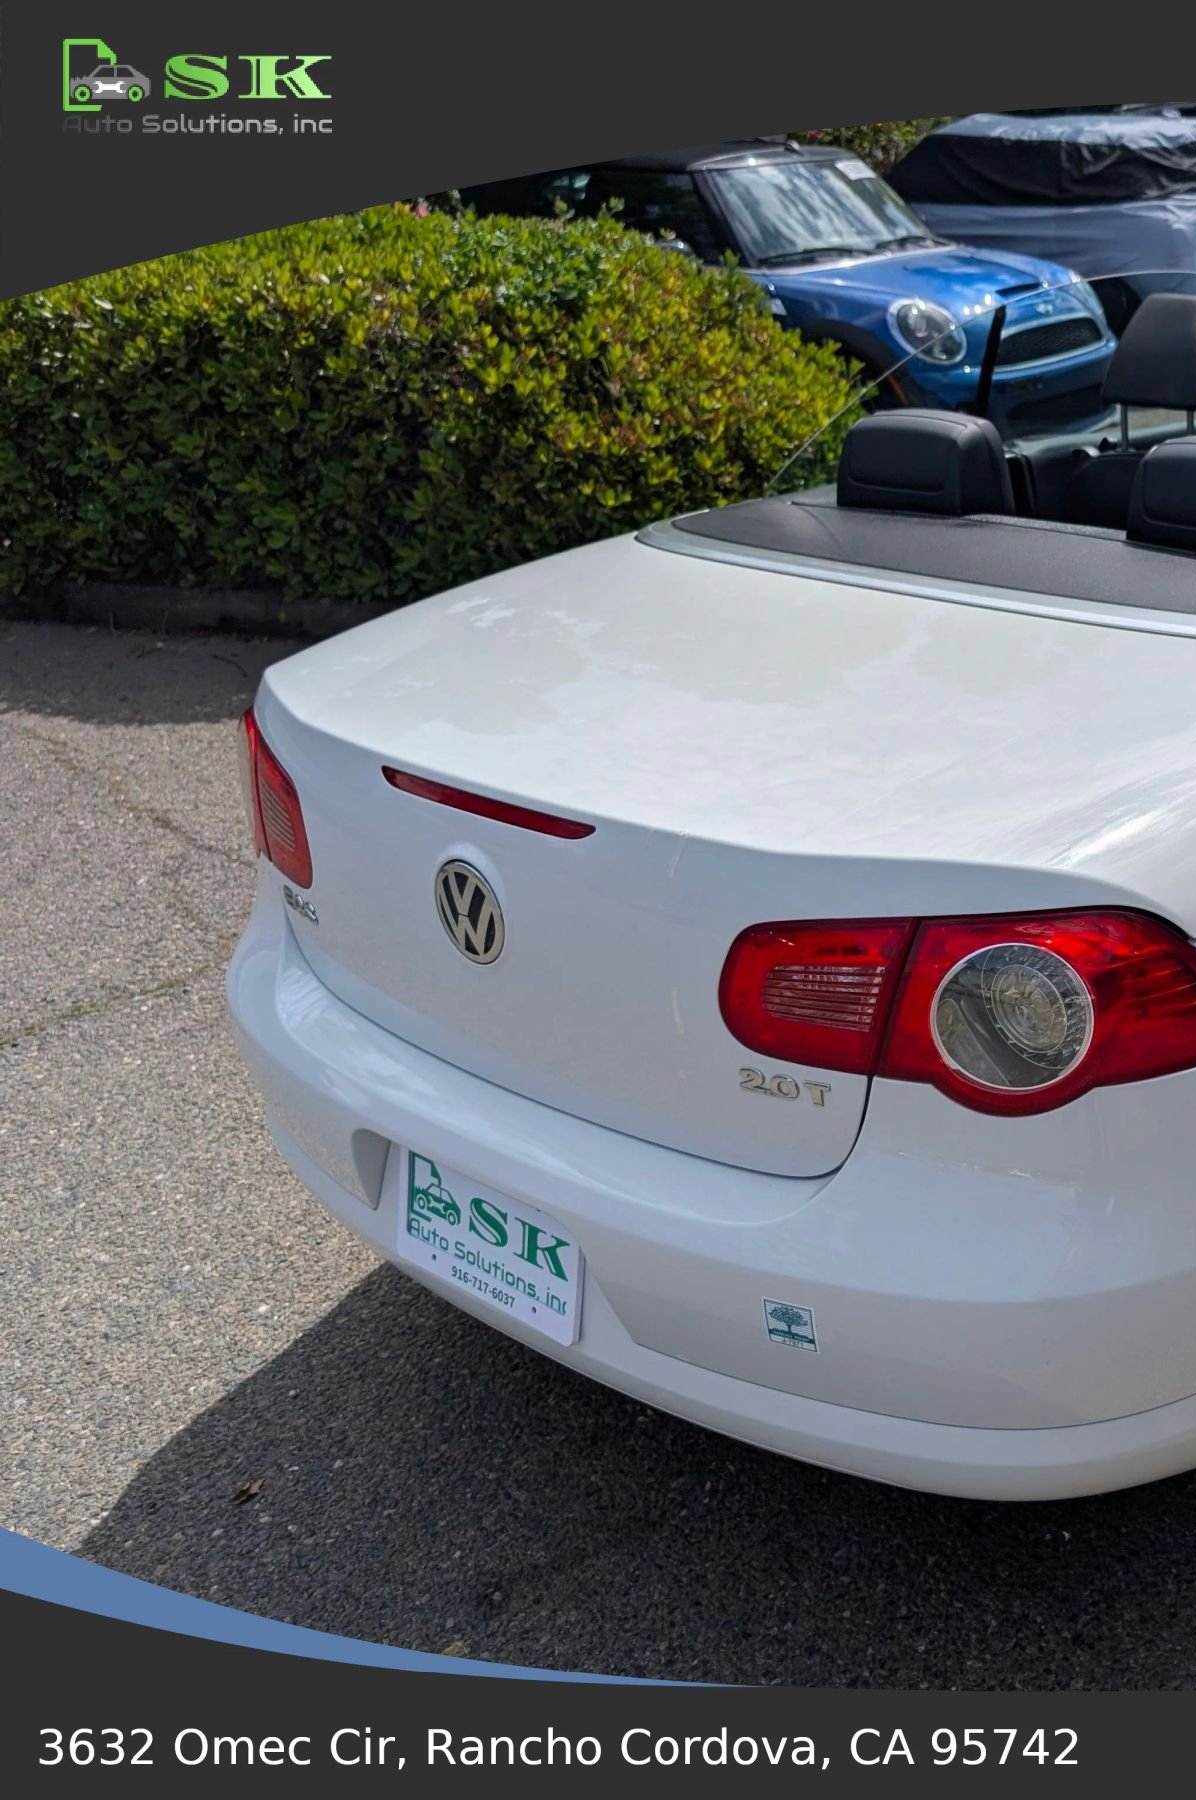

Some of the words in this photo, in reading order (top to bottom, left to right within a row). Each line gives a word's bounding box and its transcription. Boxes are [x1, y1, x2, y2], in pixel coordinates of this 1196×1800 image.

[409, 1218, 450, 1251] Auto
[454, 1241, 540, 1301] Solutions,
[469, 1197, 570, 1282] SK
[451, 1265, 516, 1308] 916-717-6037
